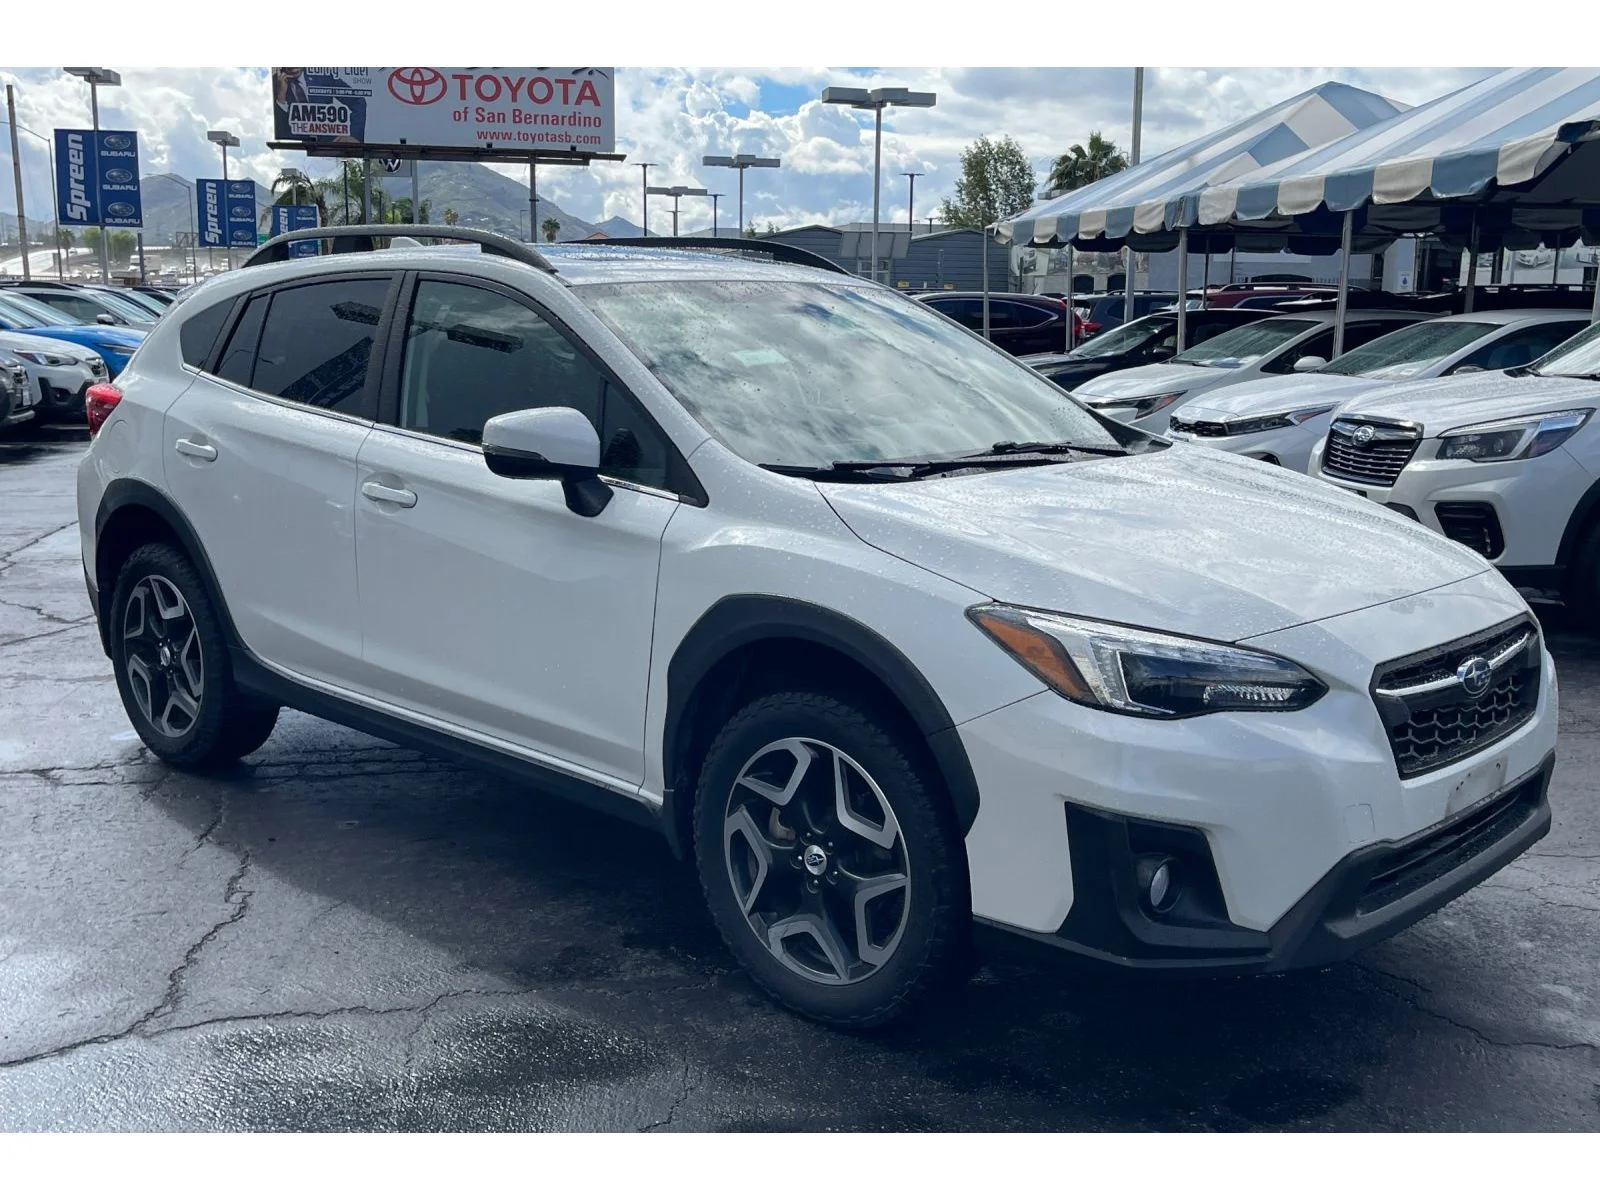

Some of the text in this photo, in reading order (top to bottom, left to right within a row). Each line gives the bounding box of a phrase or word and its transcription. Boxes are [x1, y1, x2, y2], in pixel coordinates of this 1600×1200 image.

[451, 74, 601, 106] TOYOTA
[291, 104, 348, 123] AM590
[453, 107, 602, 128] of San Bernardino
[291, 123, 348, 134] THE ANSWER
[476, 129, 601, 144] www.toyotasb.com
[67, 134, 90, 221] Spreen
[205, 182, 222, 243] Spreen
